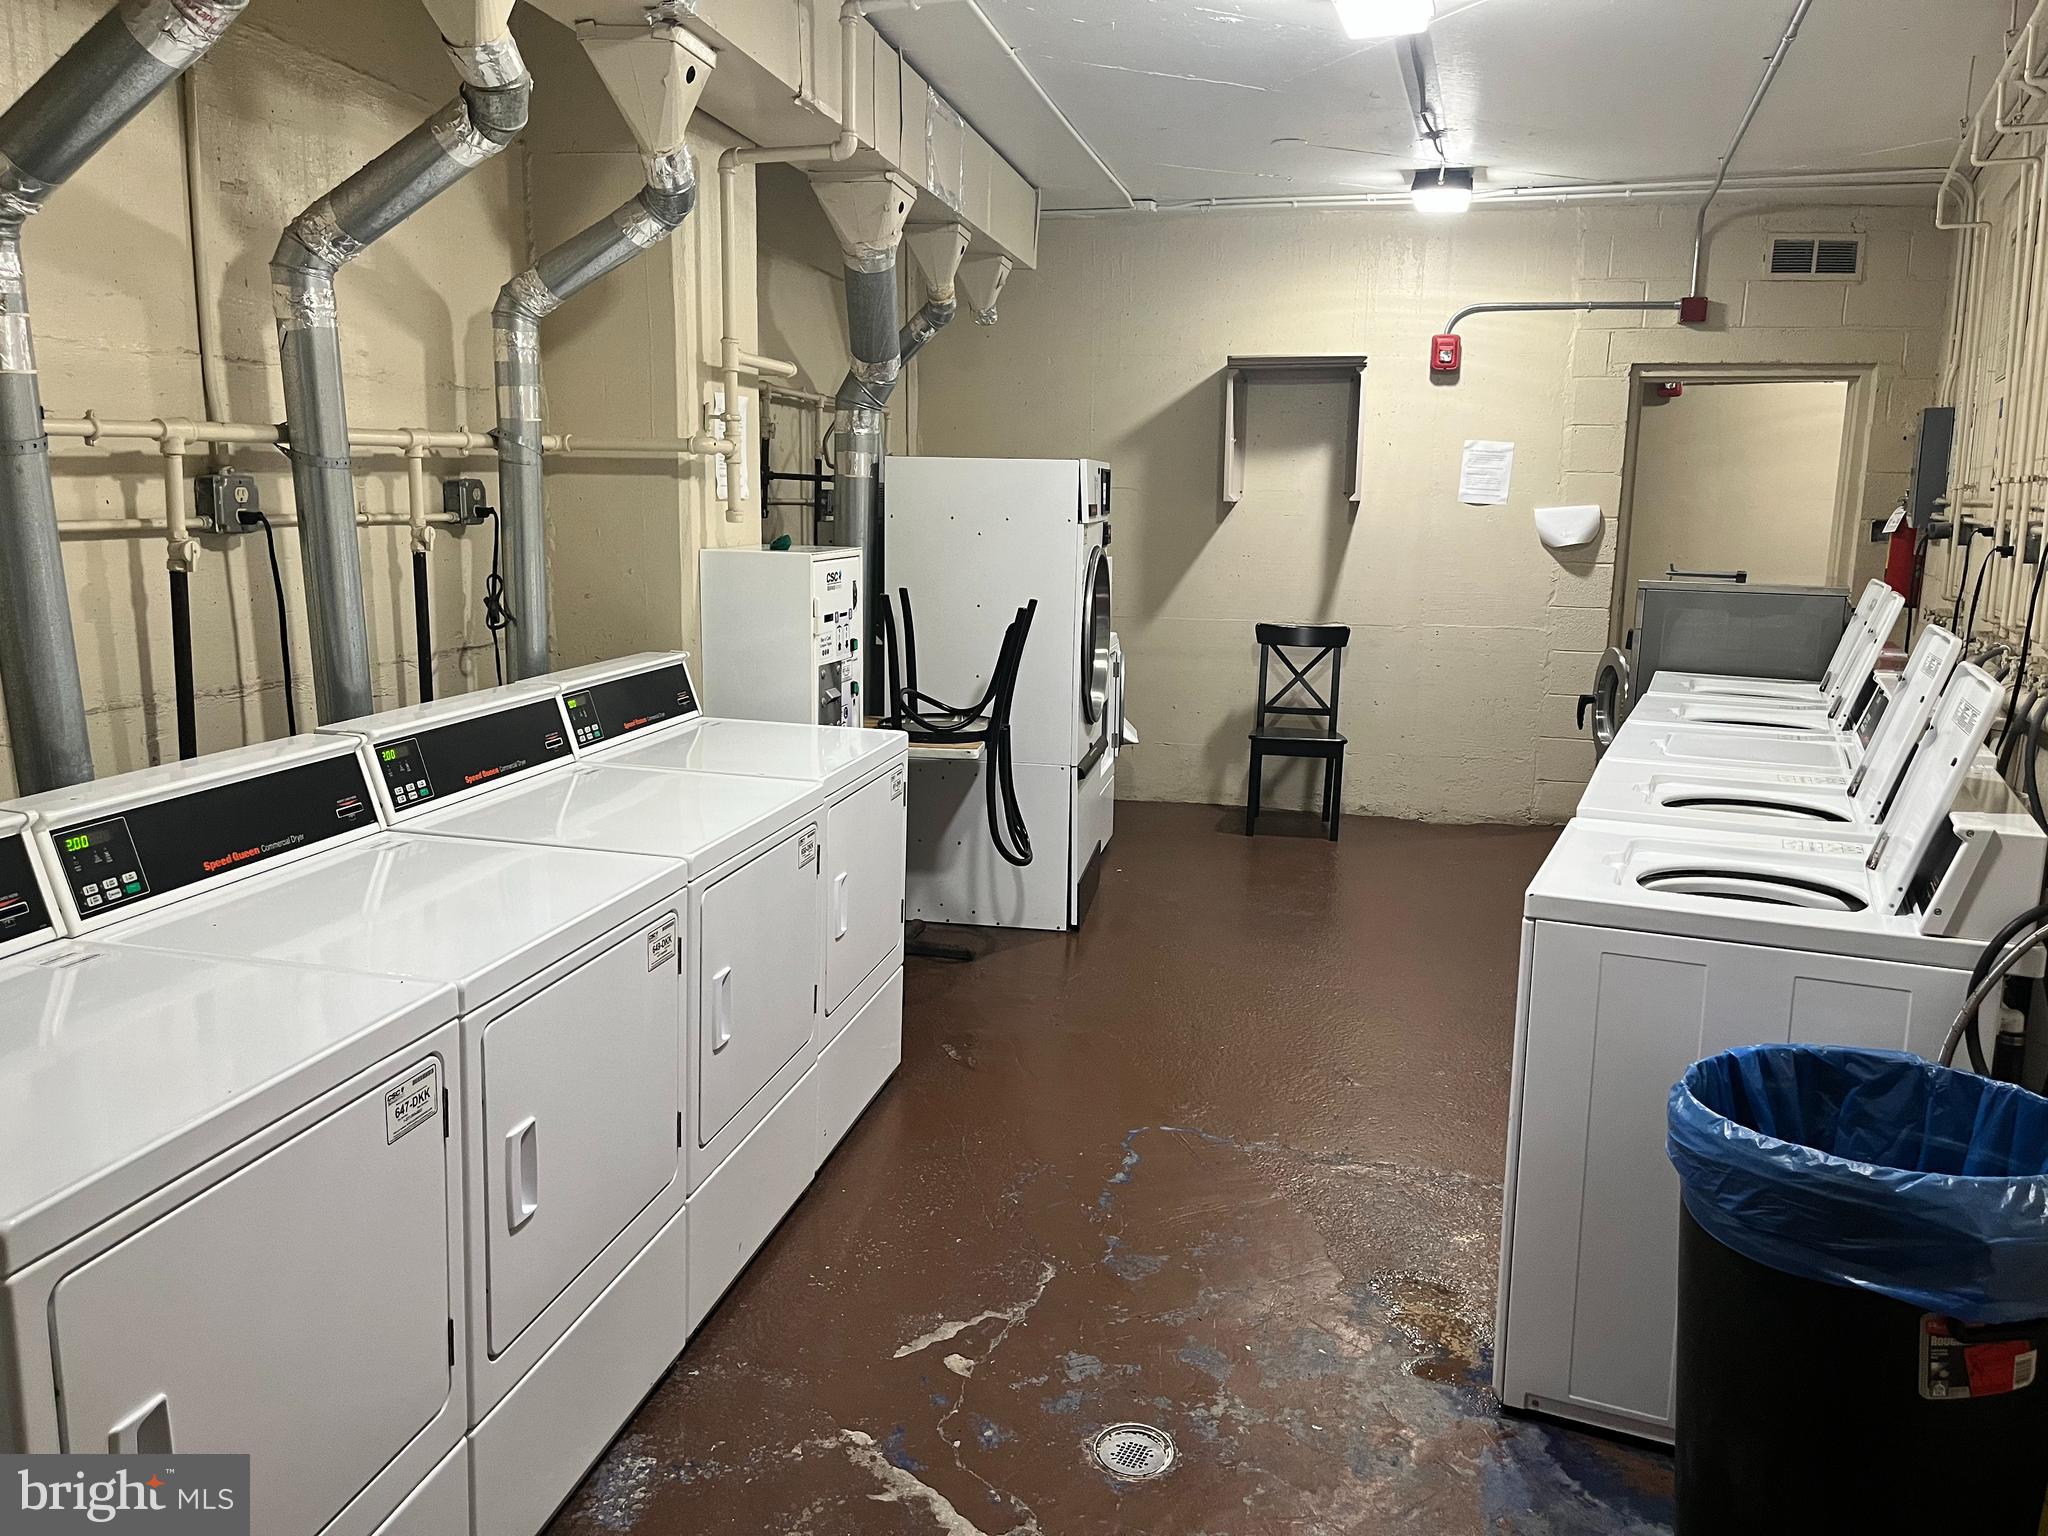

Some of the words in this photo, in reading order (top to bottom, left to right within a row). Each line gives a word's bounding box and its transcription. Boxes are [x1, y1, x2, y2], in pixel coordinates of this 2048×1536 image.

[826, 571, 839, 584] CSC
[202, 853, 232, 872] Speed
[232, 845, 261, 863] Queen
[260, 837, 291, 854] Commercial
[290, 832, 305, 847] Dryer
[394, 1086, 431, 1119] 647-DKK
